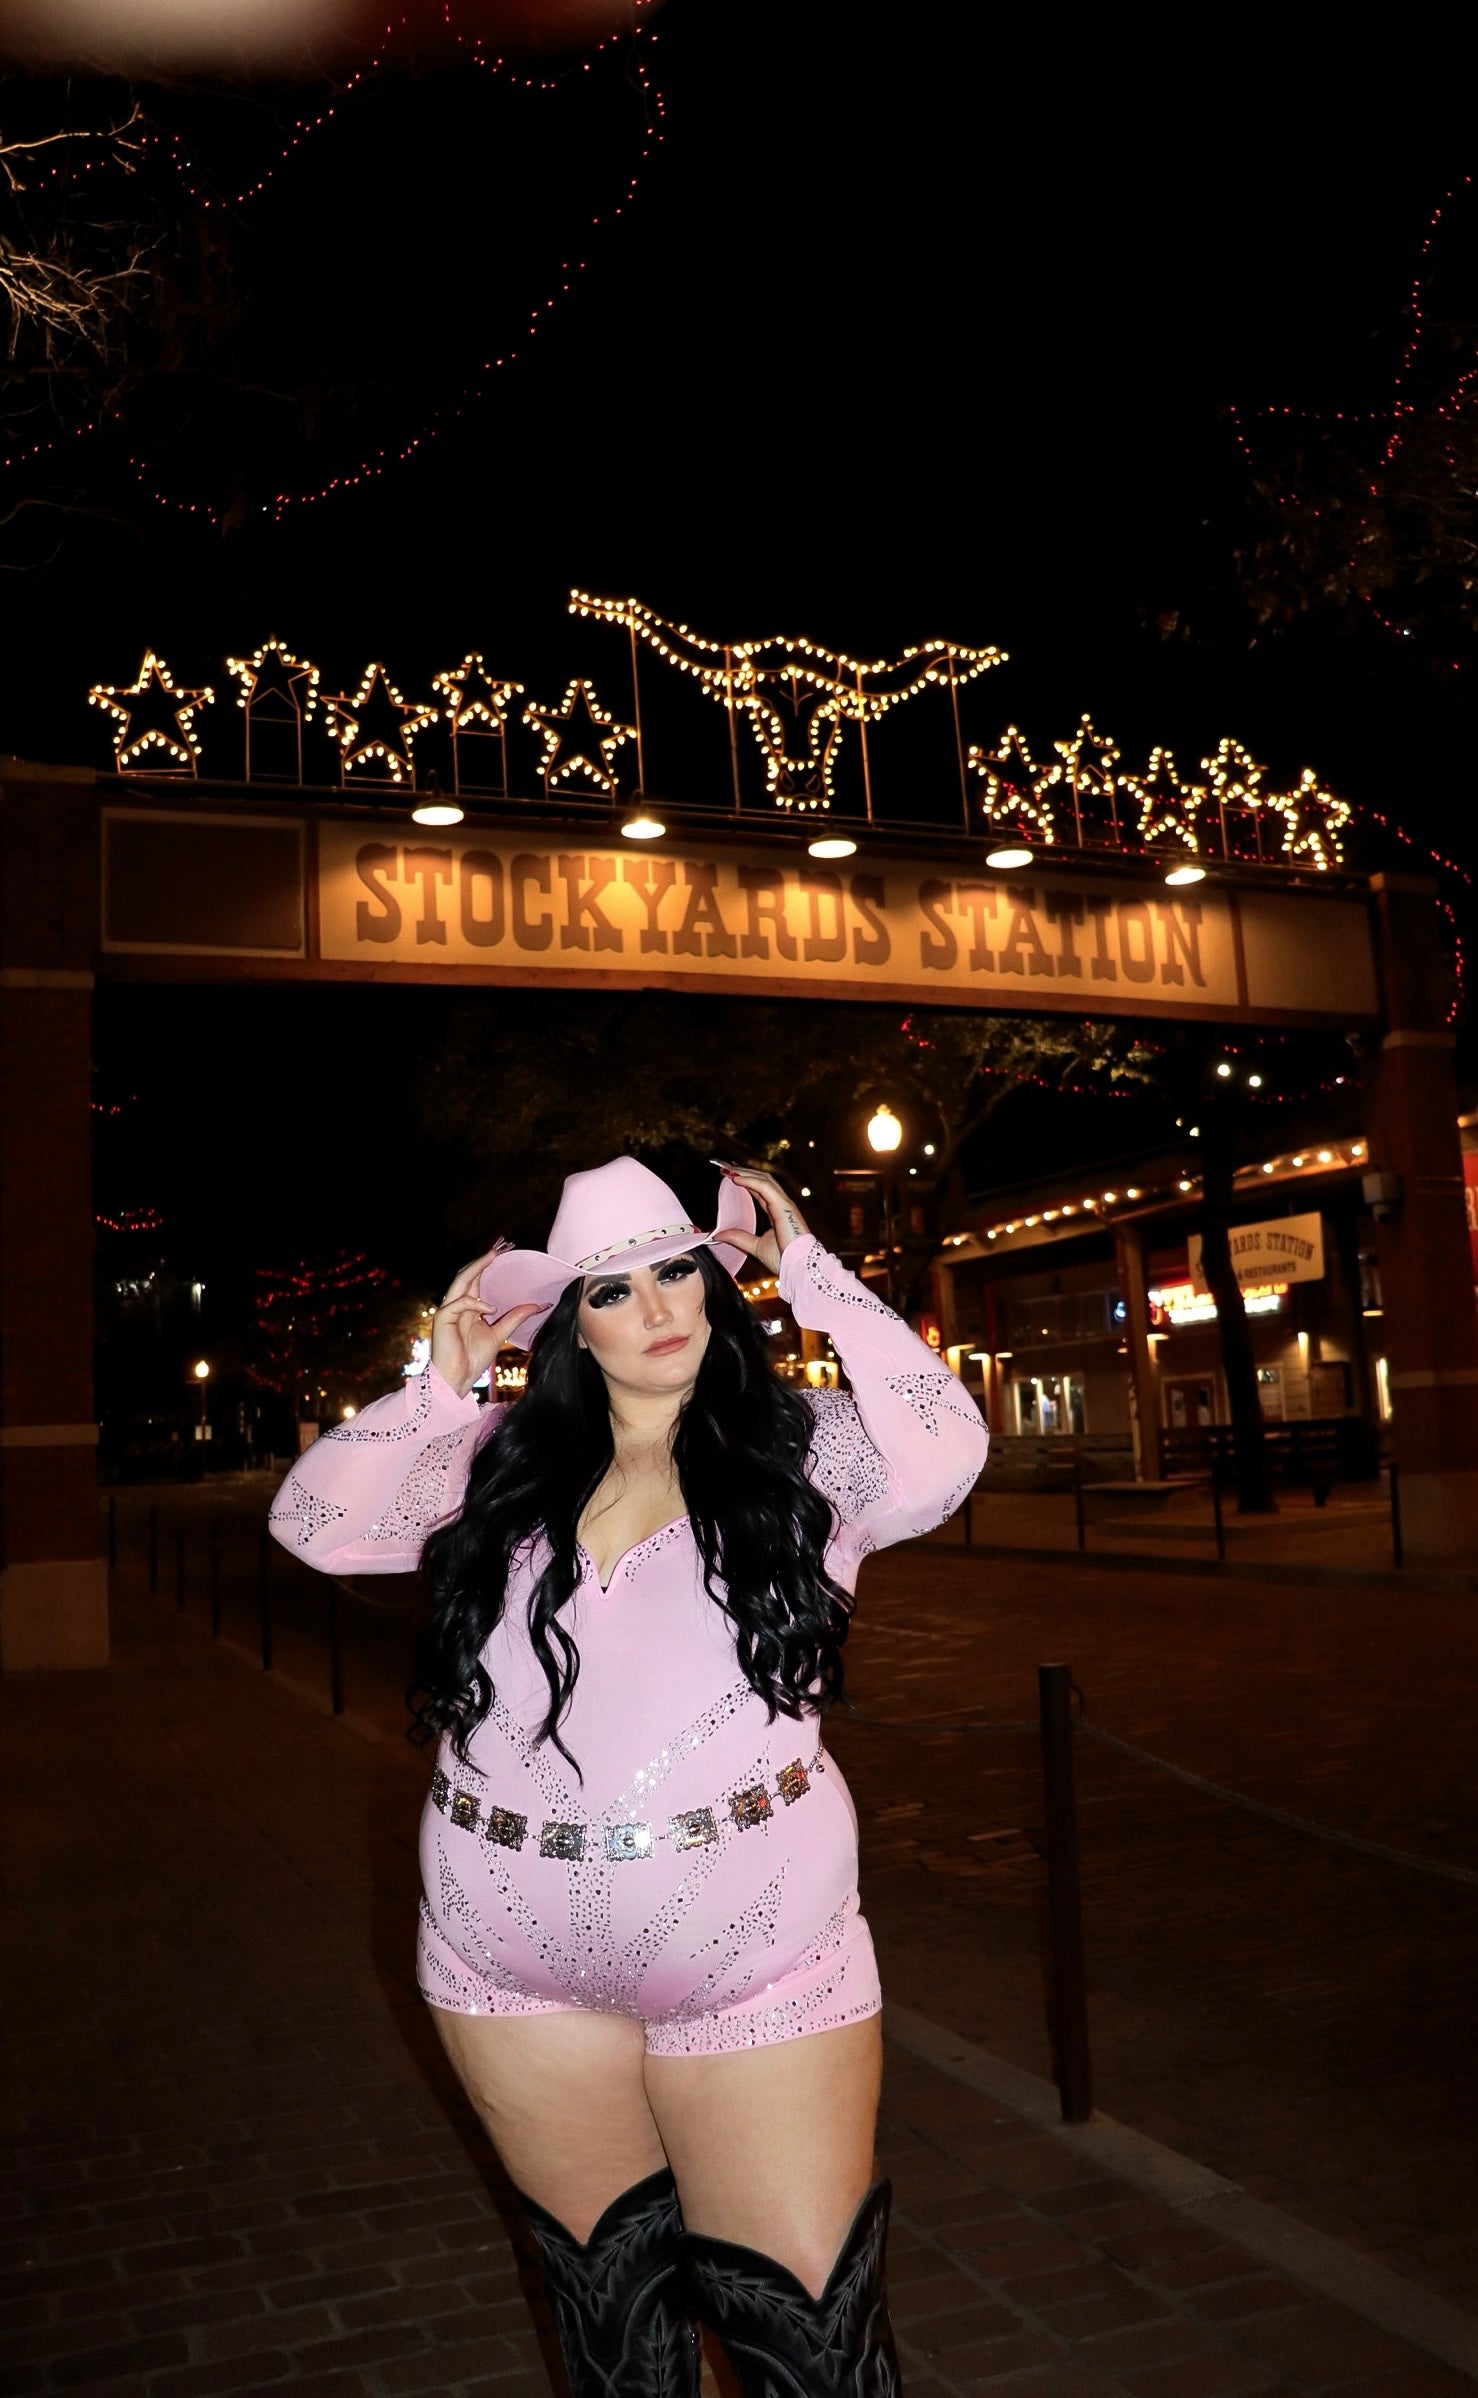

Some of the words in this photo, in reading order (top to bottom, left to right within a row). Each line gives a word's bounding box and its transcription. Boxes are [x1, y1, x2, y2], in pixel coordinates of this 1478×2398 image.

[356, 842, 892, 966] STOCKYARDS
[918, 878, 1207, 988] STATION
[1266, 1231, 1314, 1262] STATION
